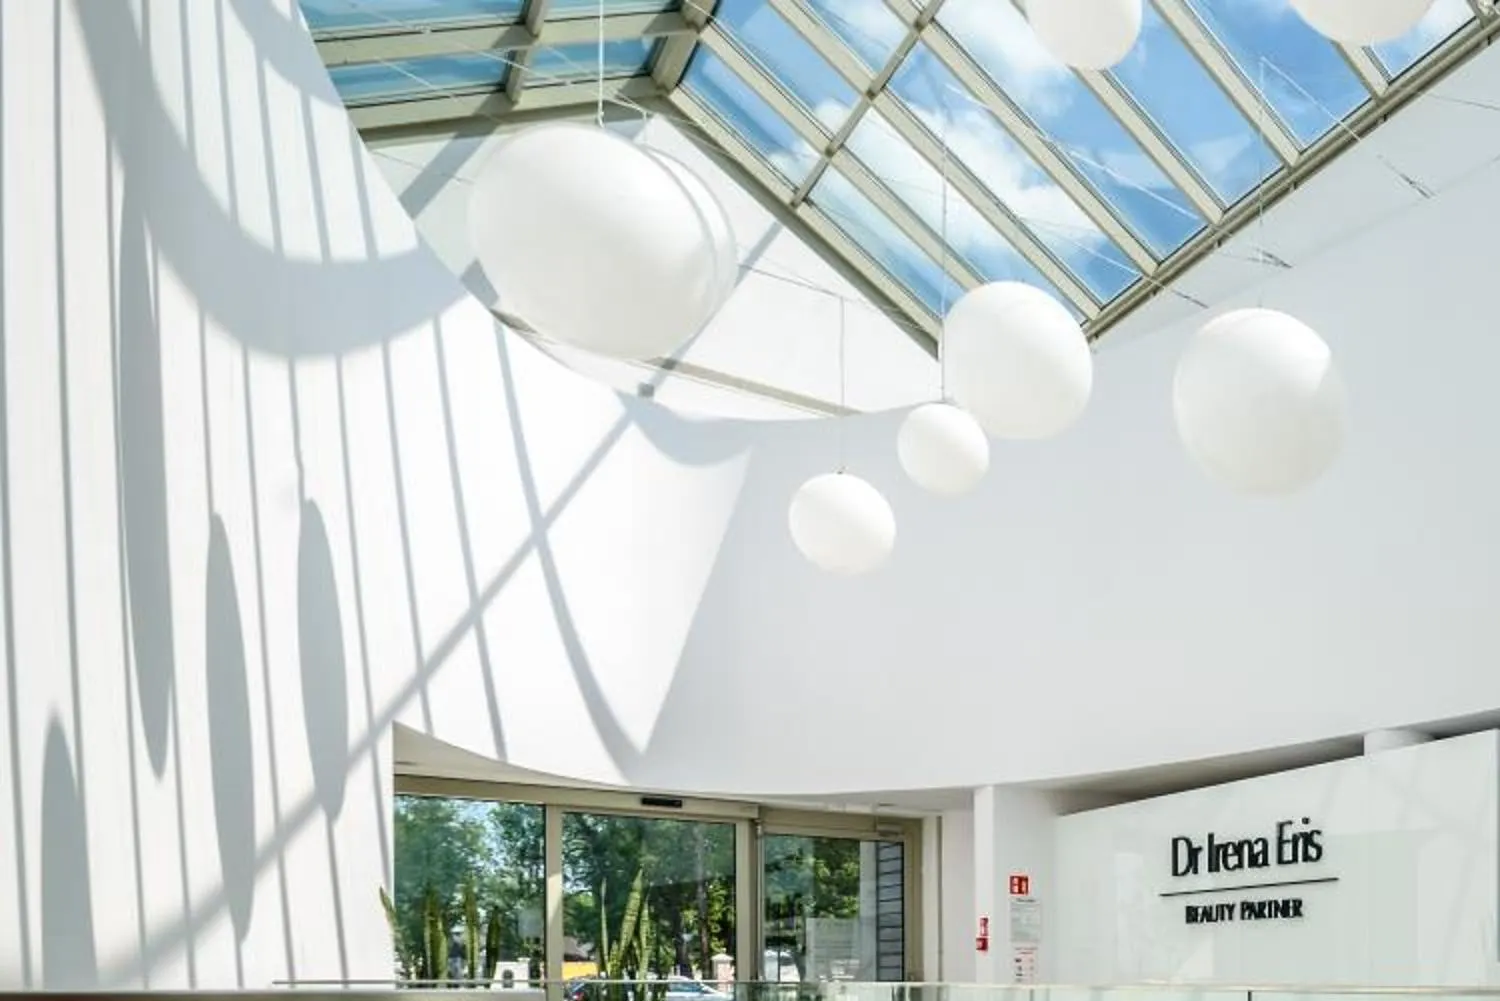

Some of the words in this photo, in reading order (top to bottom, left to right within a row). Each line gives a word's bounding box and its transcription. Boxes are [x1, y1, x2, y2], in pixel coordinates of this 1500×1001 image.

[1171, 836, 1202, 876] Dr
[1207, 832, 1269, 872] Irena
[1276, 817, 1323, 864] Eris
[1185, 903, 1235, 923] BEAUTY
[1240, 899, 1303, 920] PARTNER
